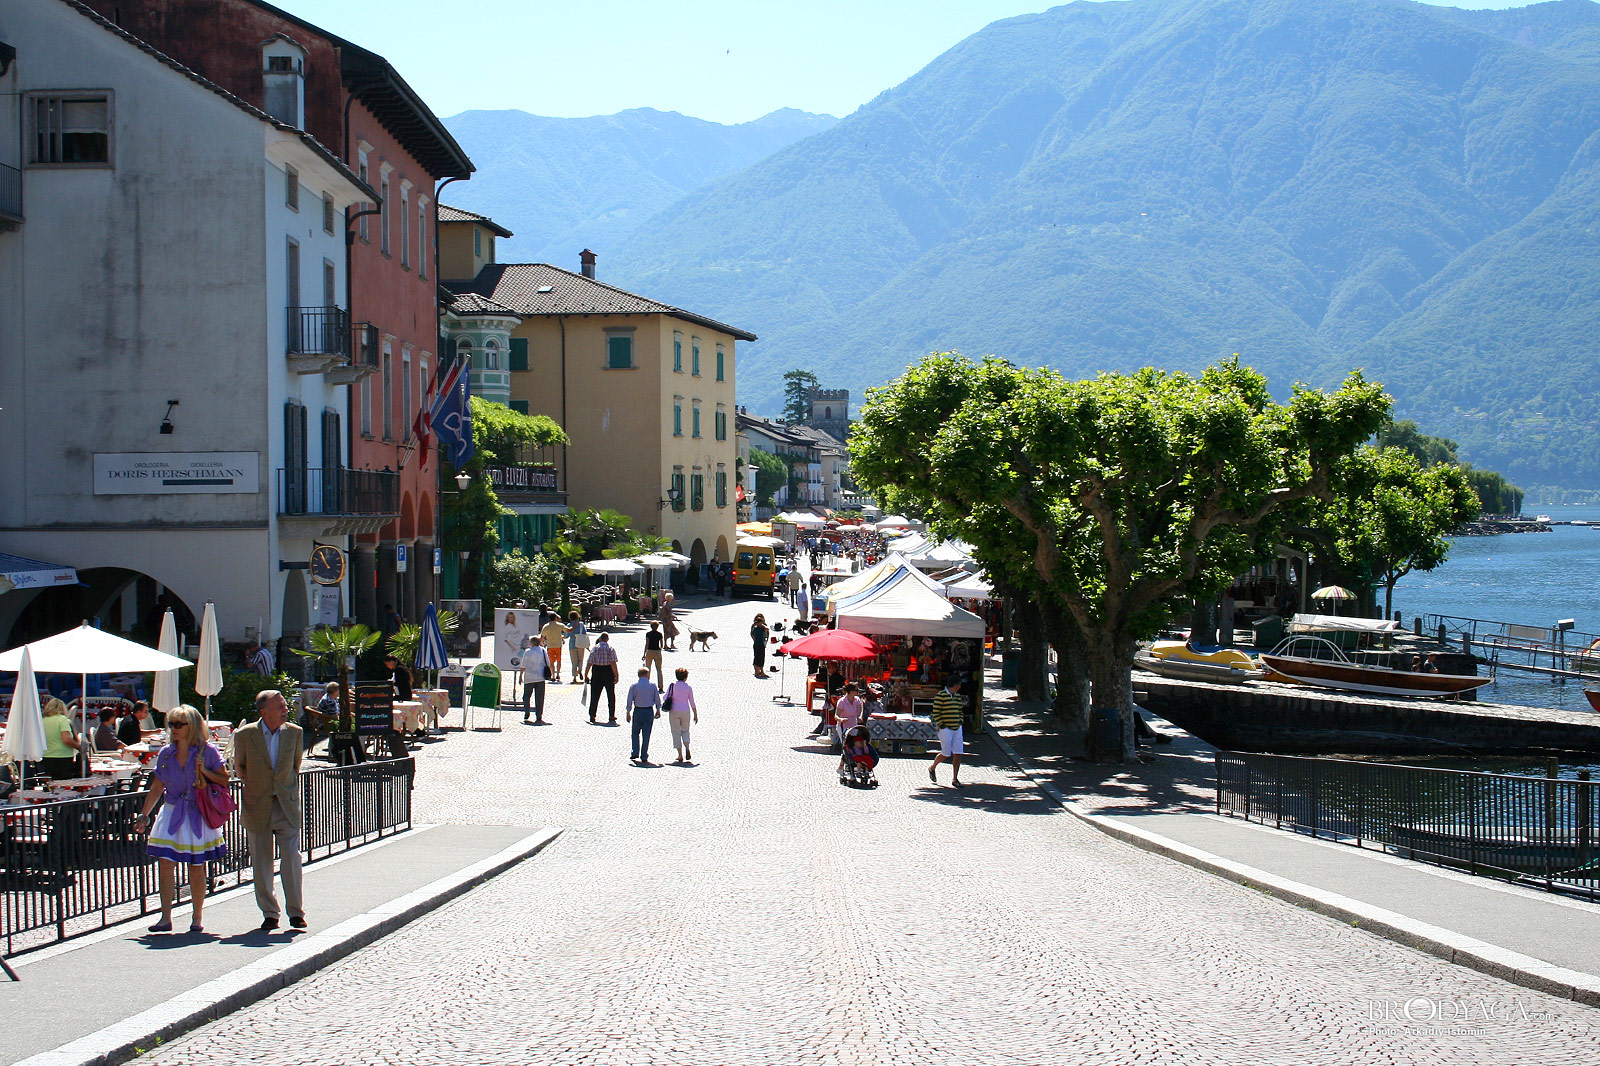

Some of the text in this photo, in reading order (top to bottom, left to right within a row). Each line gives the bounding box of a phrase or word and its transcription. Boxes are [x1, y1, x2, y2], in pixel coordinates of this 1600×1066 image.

[108, 469, 244, 479] DORIS HERSCHMANN
[399, 547, 404, 560] P
